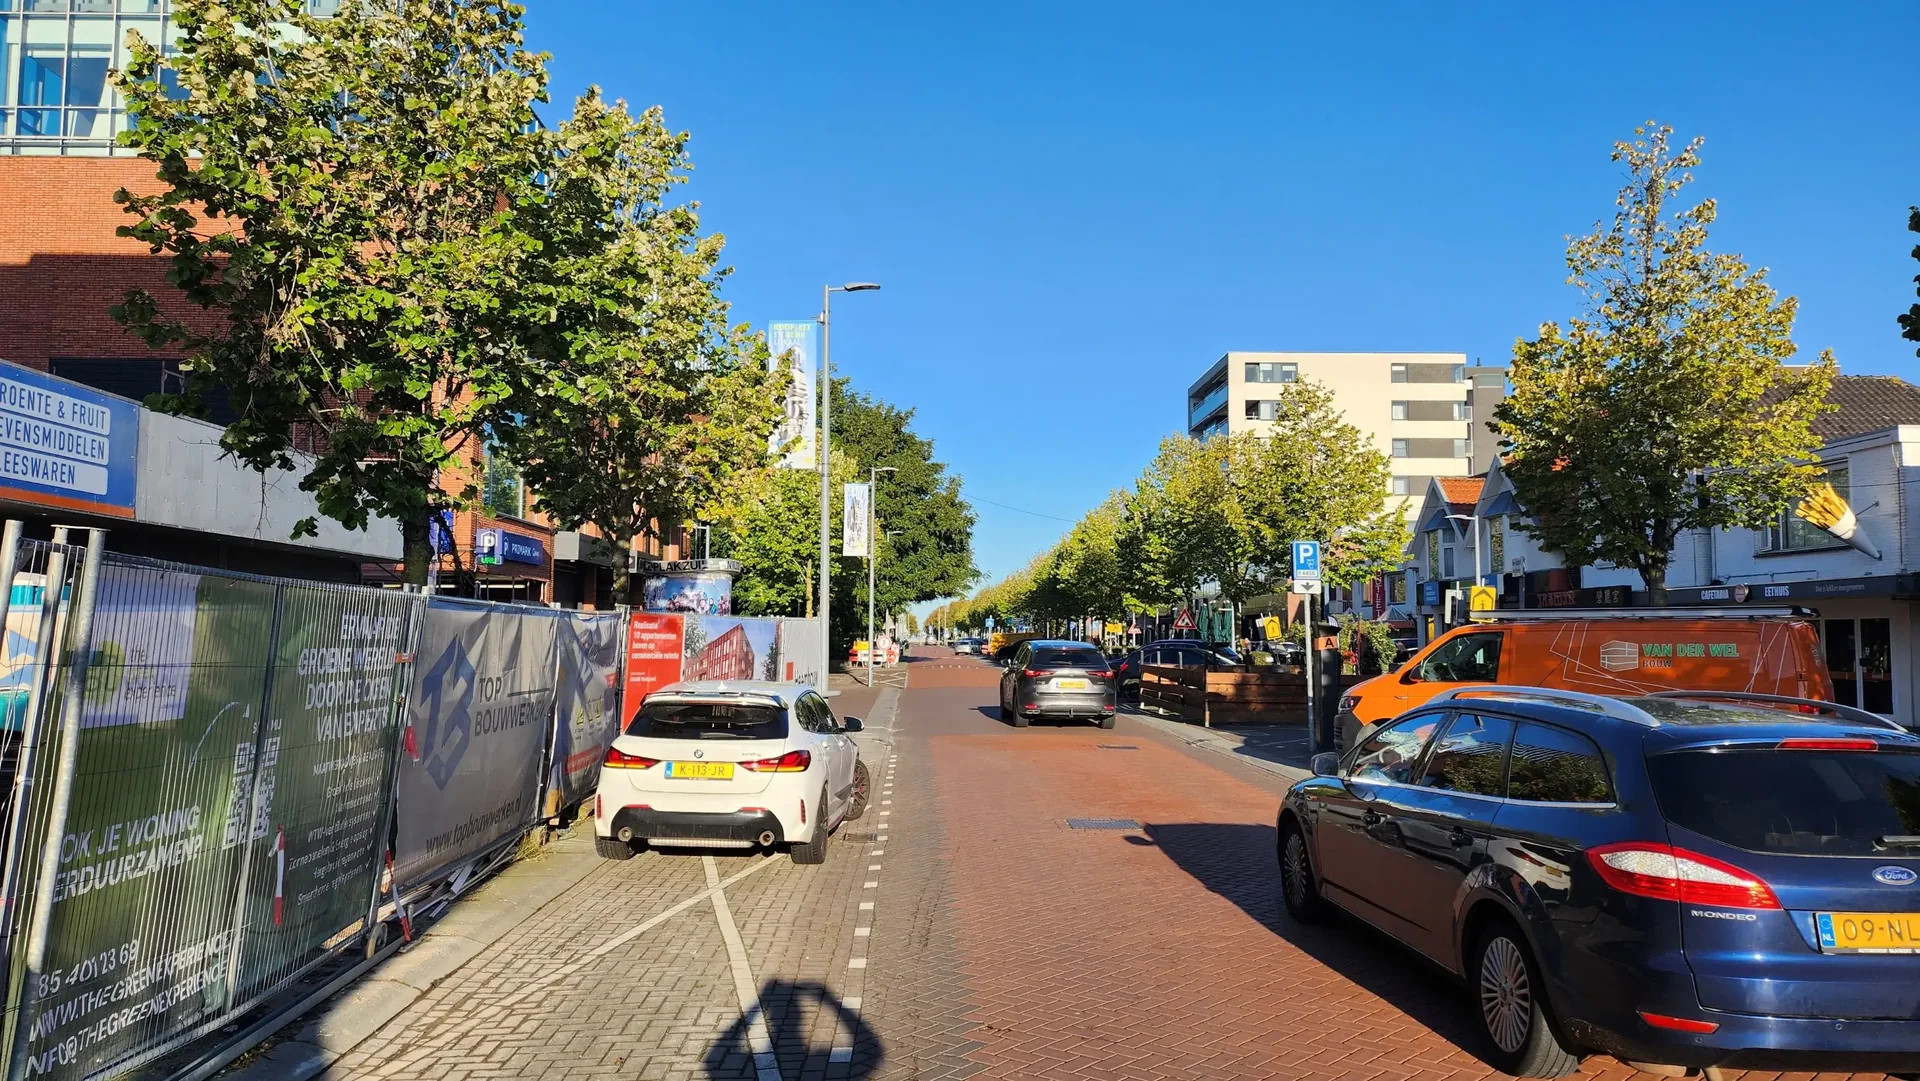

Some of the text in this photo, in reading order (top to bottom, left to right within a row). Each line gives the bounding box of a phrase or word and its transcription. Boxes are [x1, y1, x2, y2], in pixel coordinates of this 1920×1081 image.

[57, 400, 66, 419] &
[71, 402, 106, 430] FRUIT
[0, 451, 75, 485] EESWAREN
[1299, 544, 1314, 564] P
[1701, 589, 1729, 600] CAFETARIA
[1764, 586, 1790, 597] EETHUIS
[1324, 637, 1334, 648] A
[1642, 643, 1739, 657] VAN DER WEL
[130, 648, 146, 663] the
[1642, 659, 1672, 668] BOUW
[124, 682, 177, 702] experience
[305, 680, 345, 710] DOOR
[479, 676, 502, 704] TOP
[317, 713, 344, 742] VAN
[680, 764, 725, 776] K-113-JR
[96, 823, 122, 855] JE
[126, 805, 201, 848] WONING
[37, 834, 203, 904] ERDUURZAMEN?
[1884, 870, 1909, 880] Ford
[1691, 910, 1757, 921] MONDEO
[1821, 933, 1835, 941] NL
